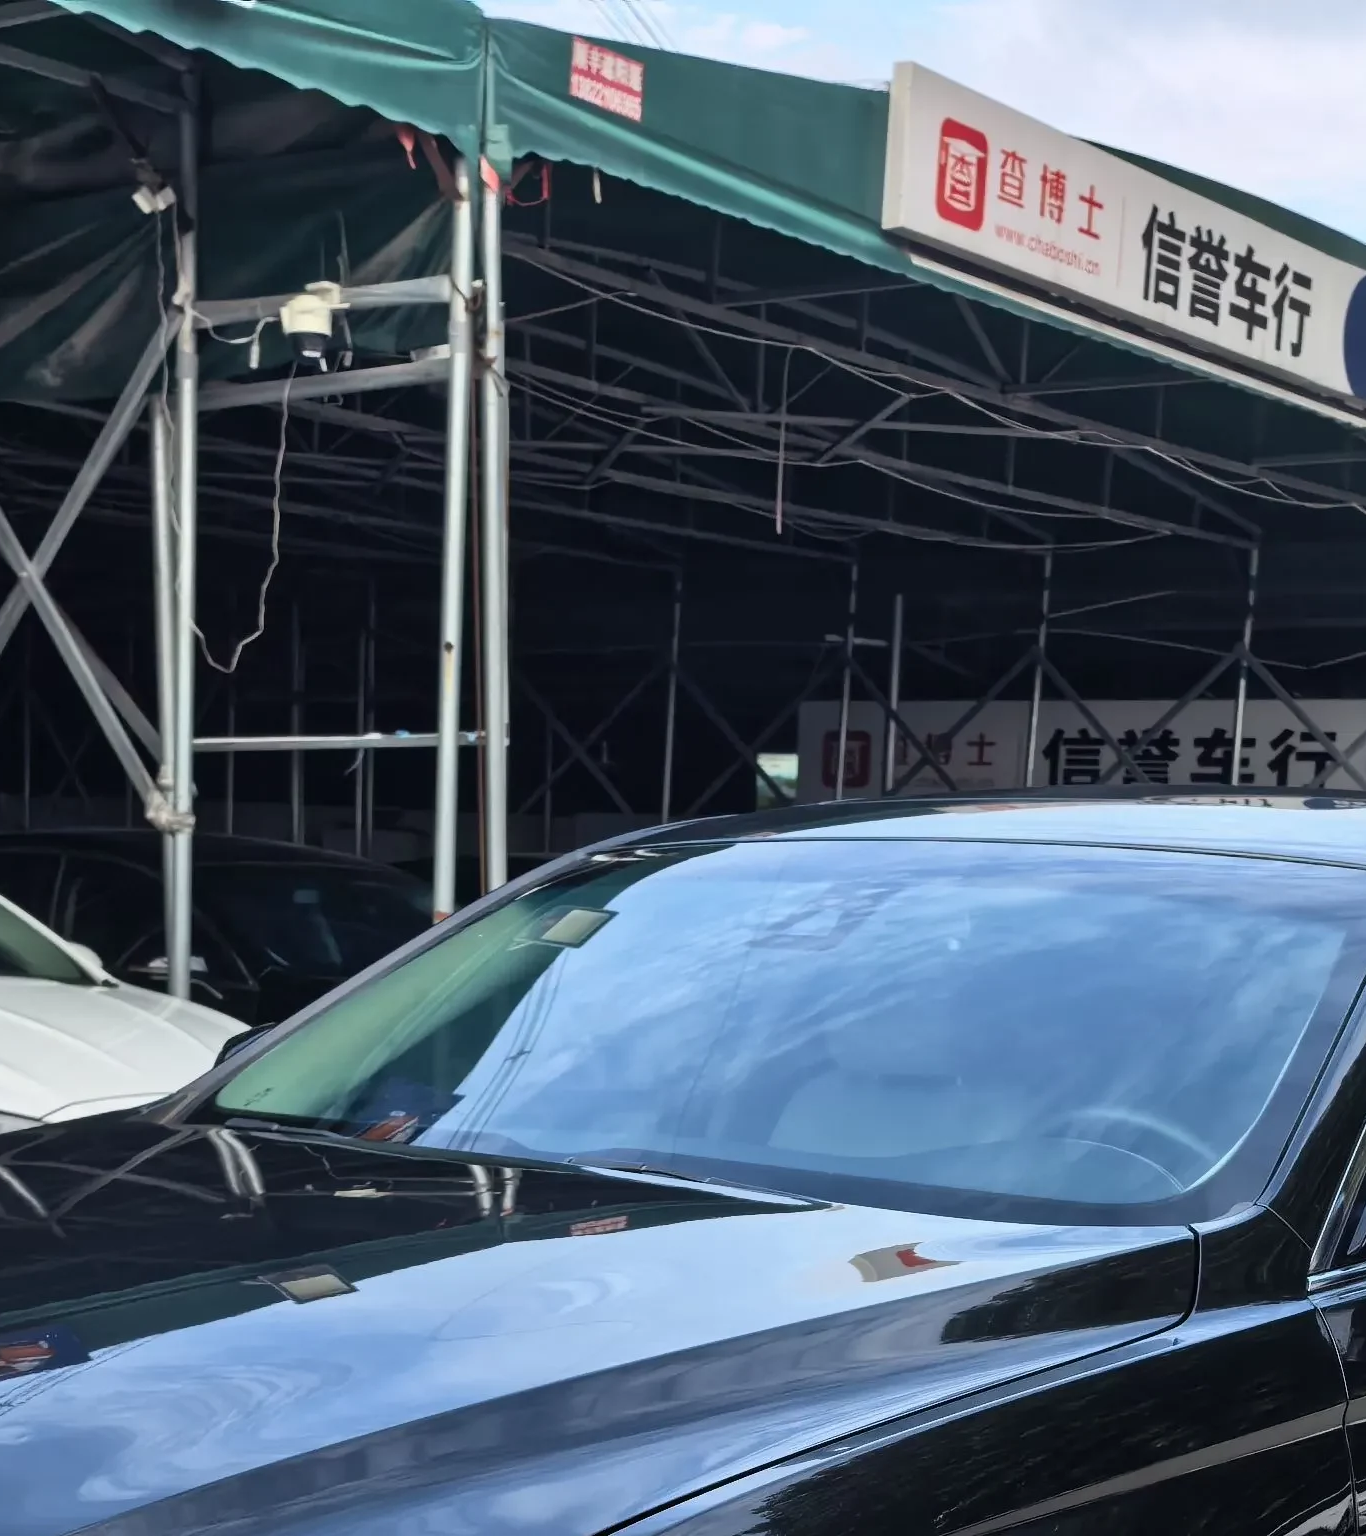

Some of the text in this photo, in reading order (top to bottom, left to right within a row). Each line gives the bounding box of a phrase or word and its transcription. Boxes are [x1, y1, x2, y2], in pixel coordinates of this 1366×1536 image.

[997, 148, 1105, 240] 查博士
[1140, 204, 1313, 357] 信誉车行
[1041, 727, 1338, 787] 信誉车行
